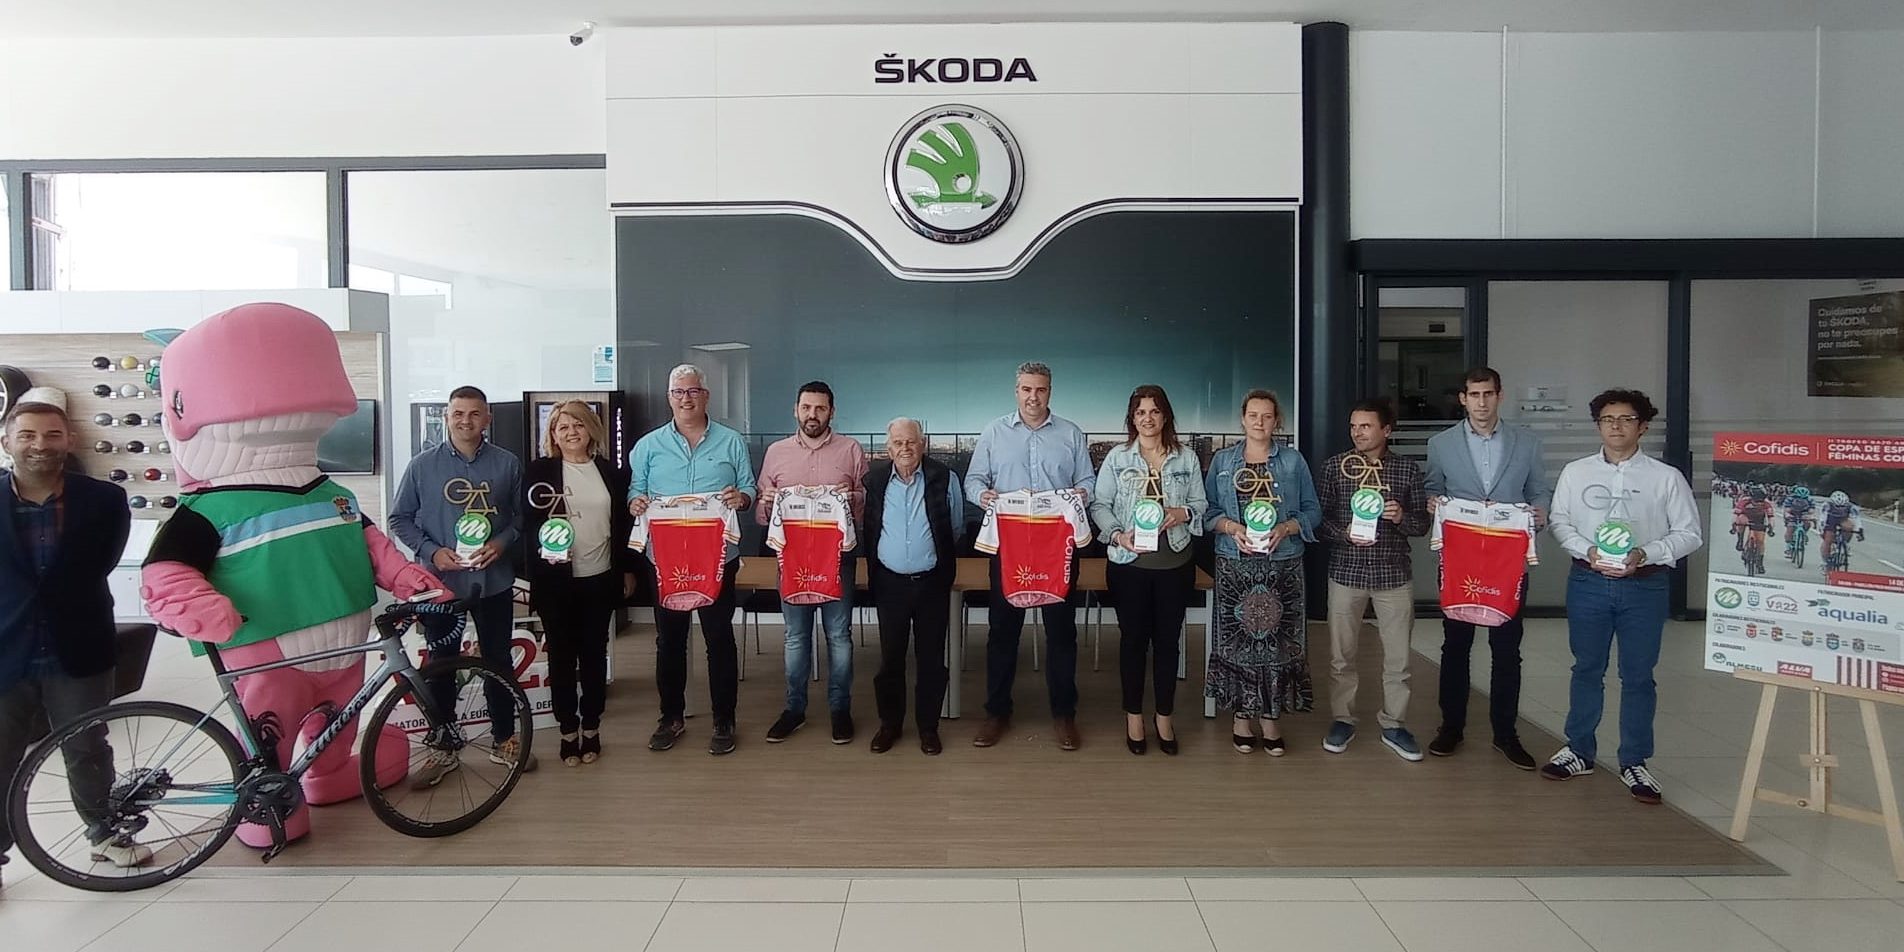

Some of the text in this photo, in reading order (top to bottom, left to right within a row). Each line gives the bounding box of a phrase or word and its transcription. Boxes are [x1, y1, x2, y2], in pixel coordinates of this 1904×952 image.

[874, 52, 1038, 84] ŠKODA
[1818, 342, 1833, 350] por
[1743, 442, 1810, 456] Cofidis
[1828, 444, 1904, 454] COPA DE ESP
[1817, 607, 1888, 624] aqualia
[395, 718, 426, 729] ATOR
[470, 710, 490, 719] EUR
